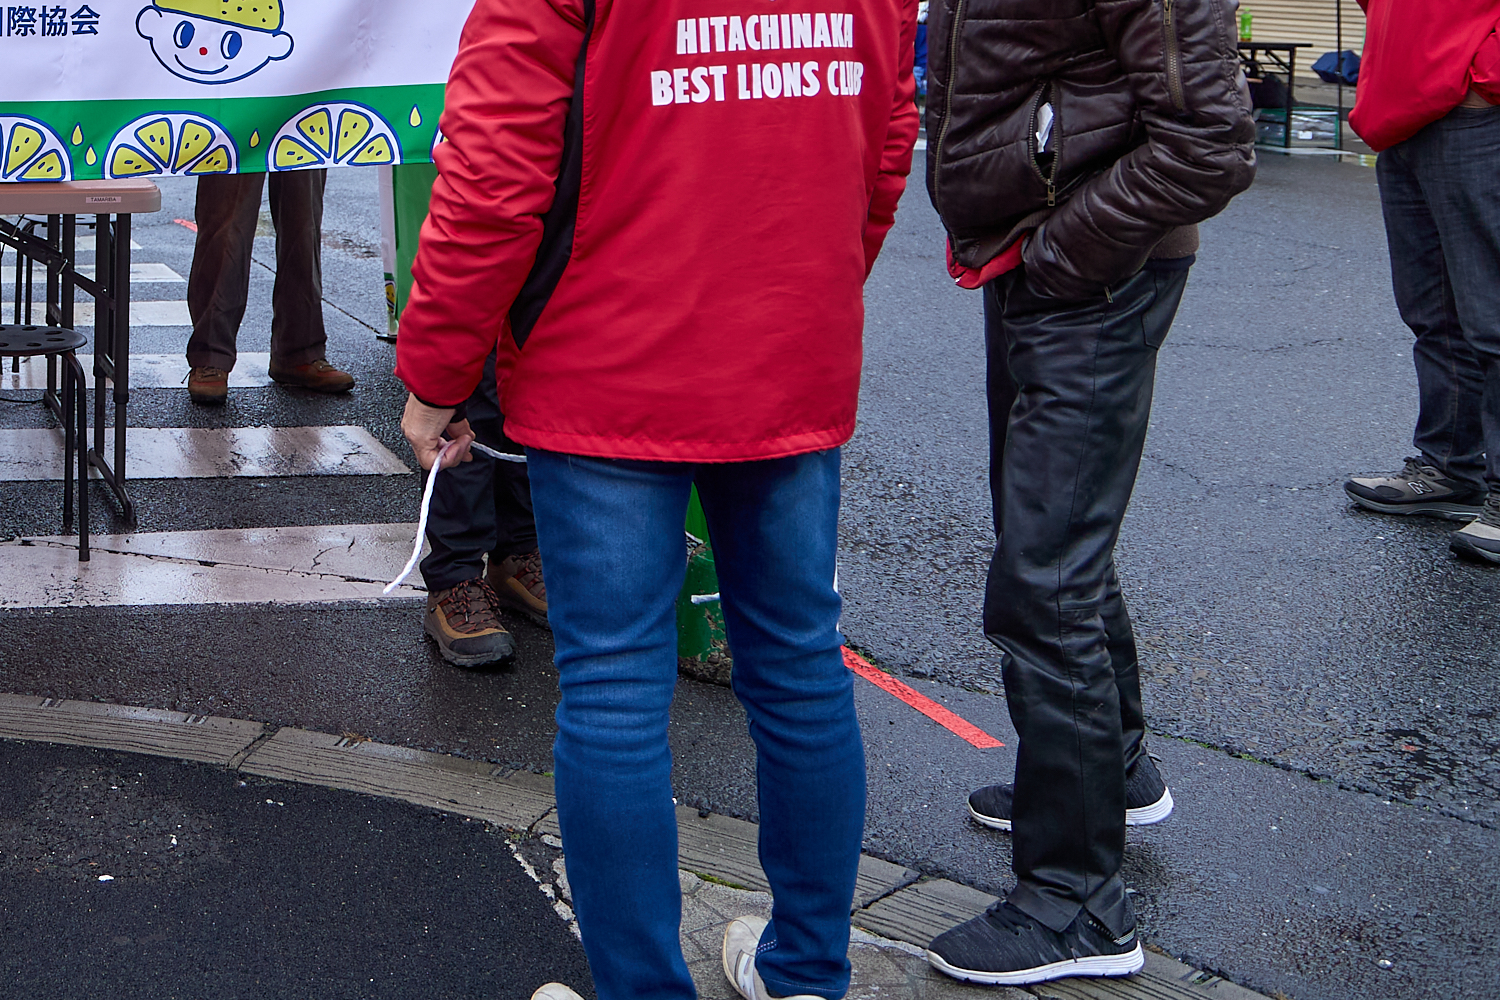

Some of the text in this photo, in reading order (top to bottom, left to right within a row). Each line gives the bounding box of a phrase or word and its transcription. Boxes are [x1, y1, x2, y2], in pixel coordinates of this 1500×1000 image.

[675, 12, 854, 55] HITACHINAKA
[650, 60, 865, 107] BEST LIONS CLUB
